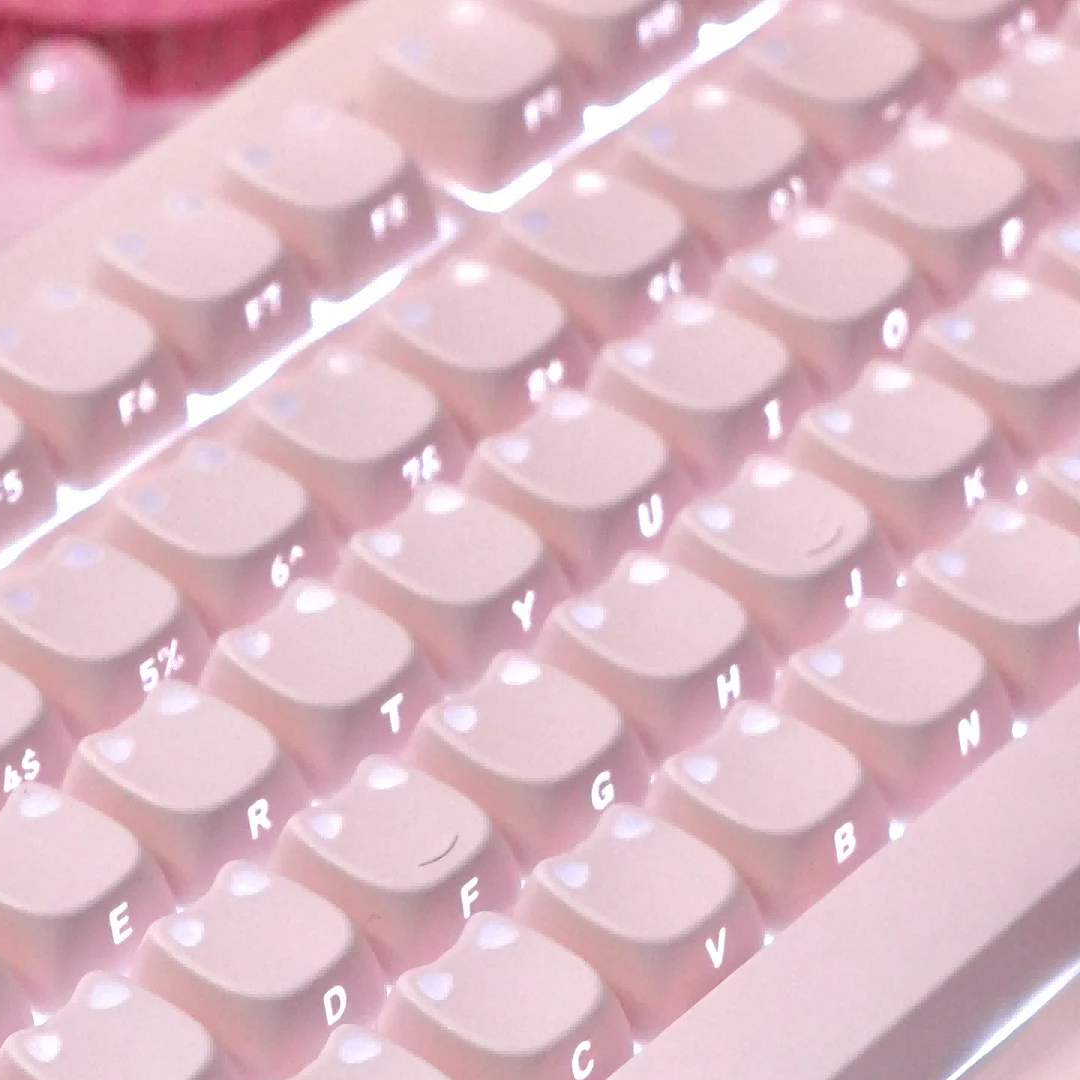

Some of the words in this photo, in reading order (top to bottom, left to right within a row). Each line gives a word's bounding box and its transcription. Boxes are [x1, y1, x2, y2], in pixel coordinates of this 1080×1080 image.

[962, 465, 986, 508] K
[637, 493, 664, 538] U
[844, 568, 863, 609] J
[511, 590, 535, 632] Y
[716, 663, 742, 710] H
[380, 692, 403, 734] T
[957, 709, 981, 756] N
[590, 770, 616, 811] G
[247, 798, 271, 840] R
[834, 821, 857, 863] B
[459, 876, 480, 920] F
[109, 901, 133, 945] E
[705, 926, 726, 969] V
[323, 985, 347, 1026] D
[571, 1040, 594, 1080] C
